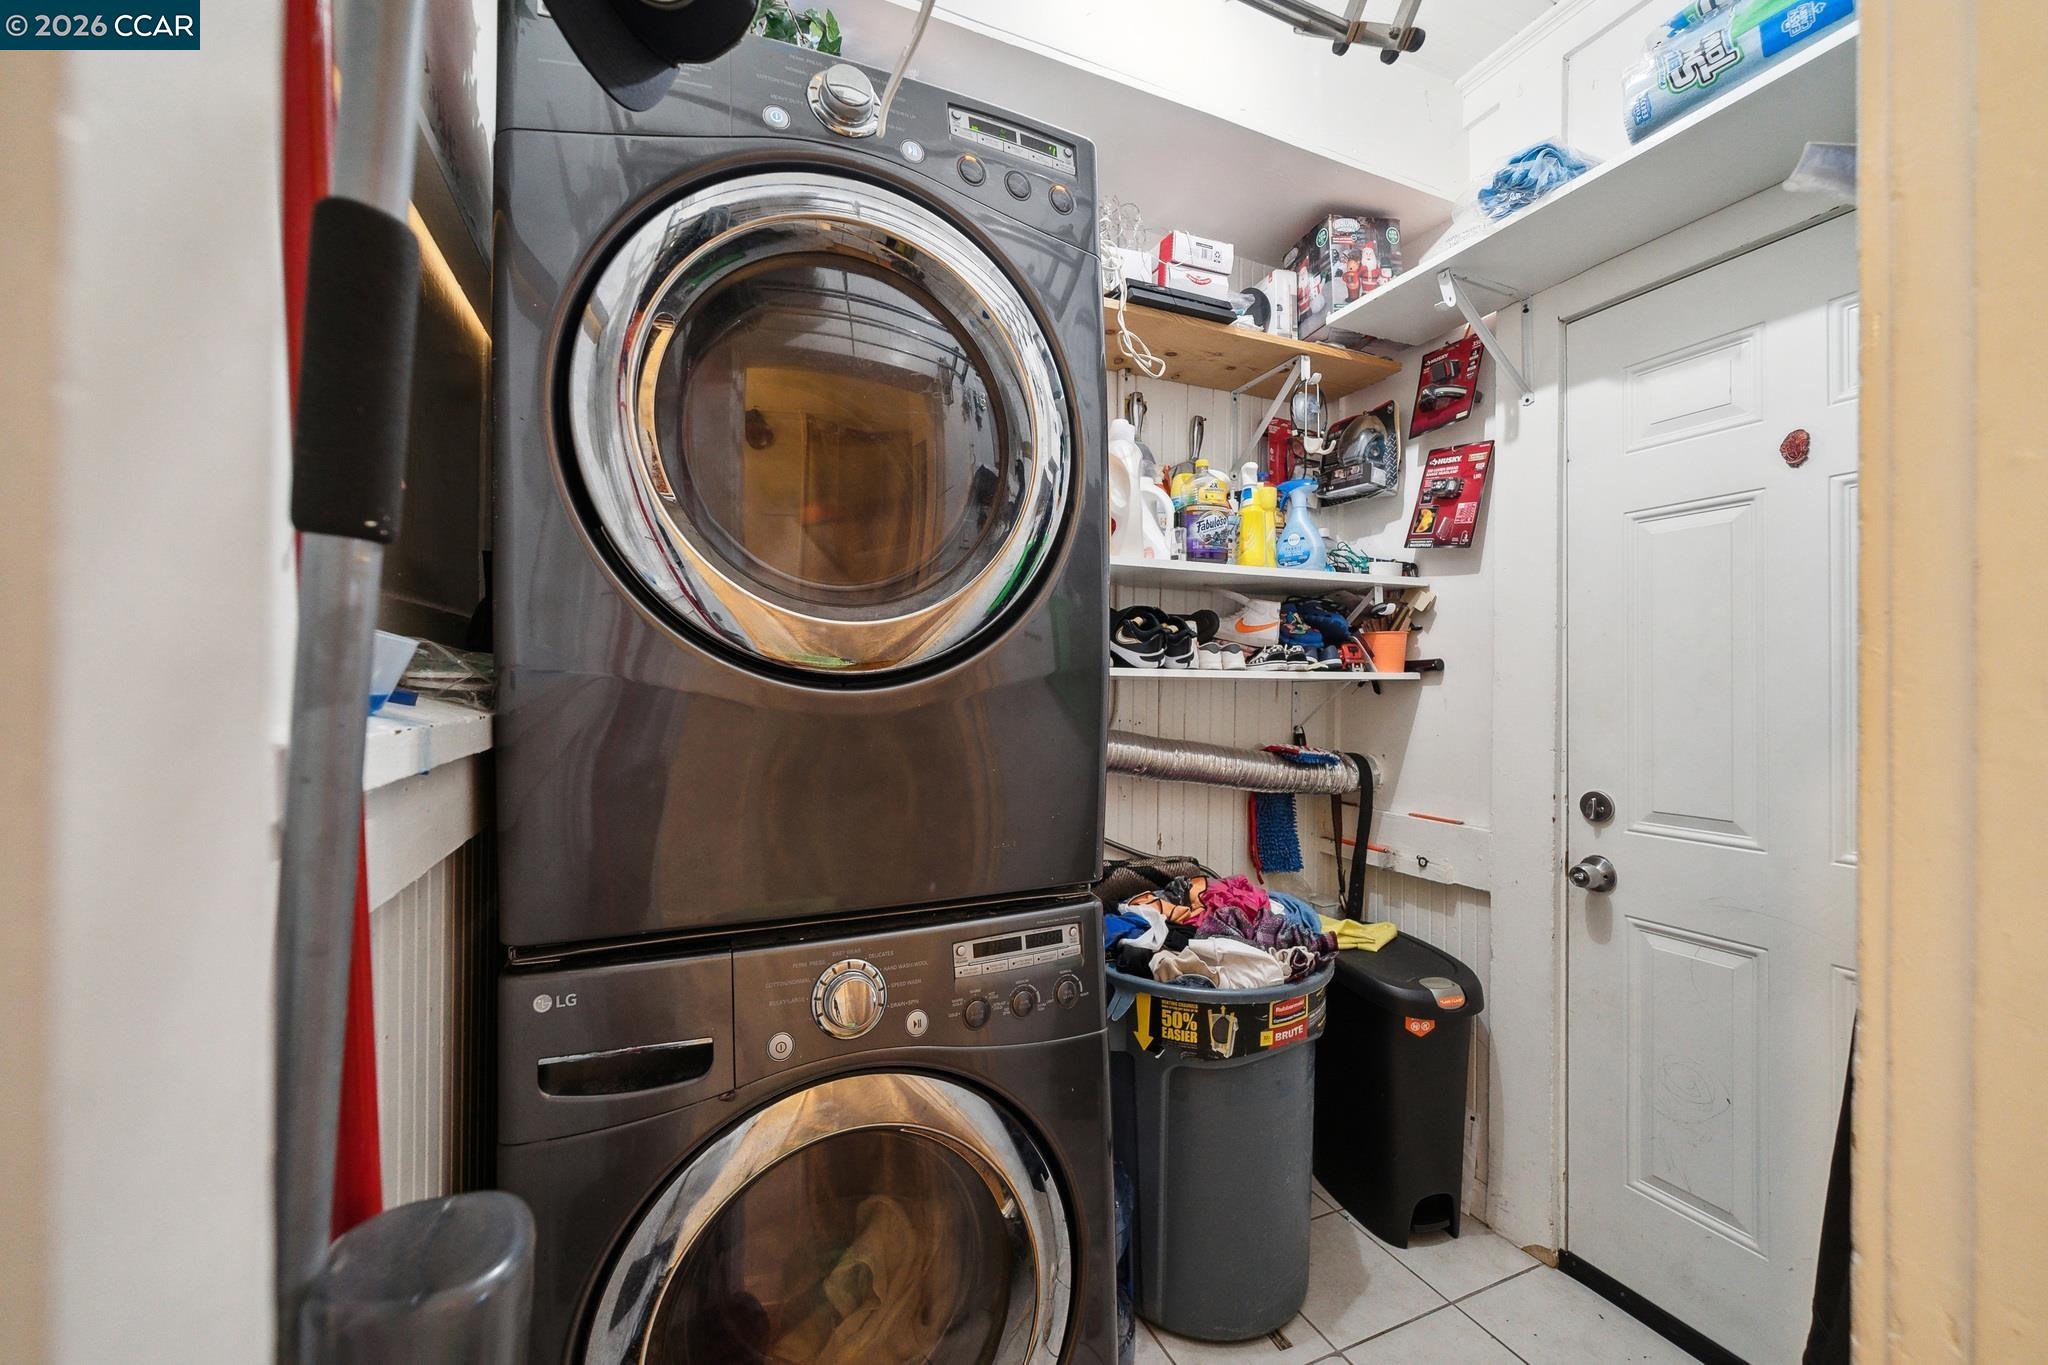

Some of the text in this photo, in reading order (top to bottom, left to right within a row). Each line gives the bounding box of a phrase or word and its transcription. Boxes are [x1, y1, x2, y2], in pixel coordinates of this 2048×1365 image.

[1437, 455, 1463, 465] HUSKY
[1196, 515, 1227, 533] Fabuloso
[556, 993, 577, 1008] LG
[1161, 1009, 1198, 1031] 50%
[1161, 1026, 1198, 1044] EASIER
[1275, 1024, 1304, 1042] BRUTE
